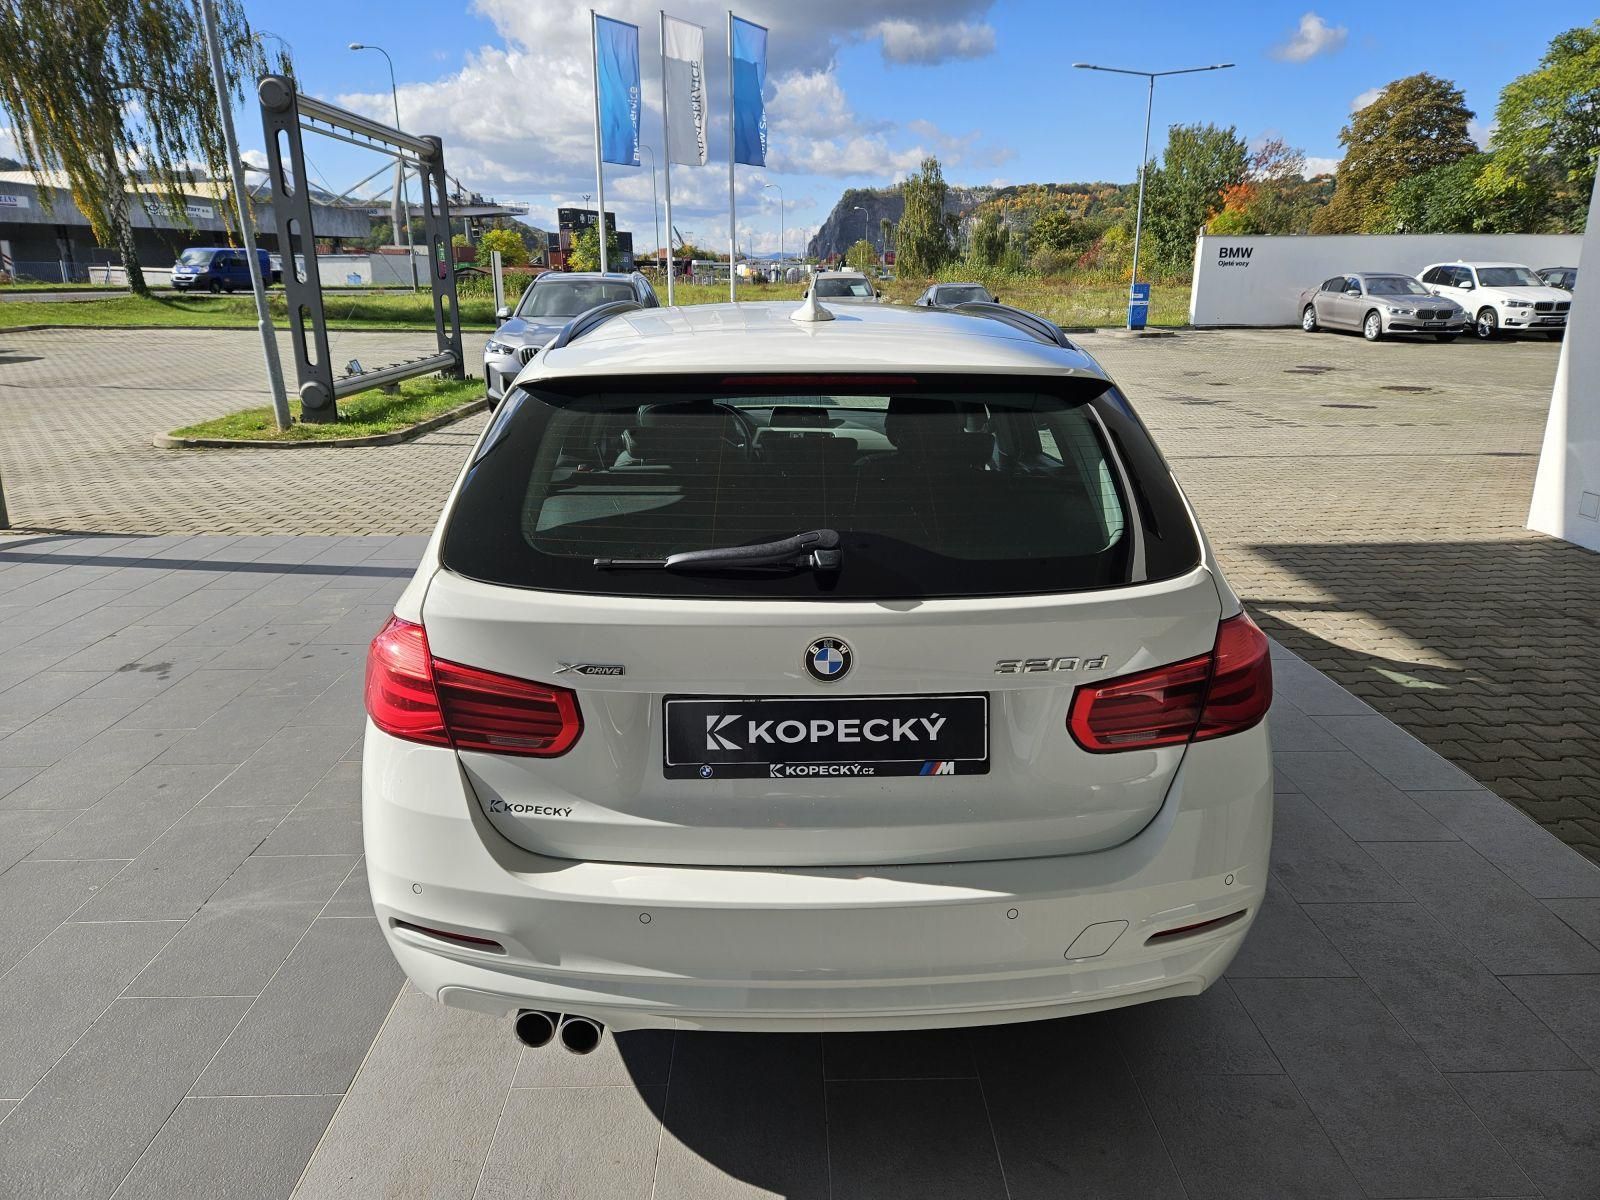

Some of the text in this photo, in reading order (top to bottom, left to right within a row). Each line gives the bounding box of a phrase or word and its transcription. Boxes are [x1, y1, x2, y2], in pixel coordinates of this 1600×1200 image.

[691, 60, 702, 121] SERVICE
[1219, 247, 1254, 259] BMW
[994, 654, 1109, 675] 320d
[748, 712, 947, 744] KOPECKÝ
[785, 763, 875, 776] KOPECKÝ.cz
[504, 803, 573, 817] KOPECKÝ
